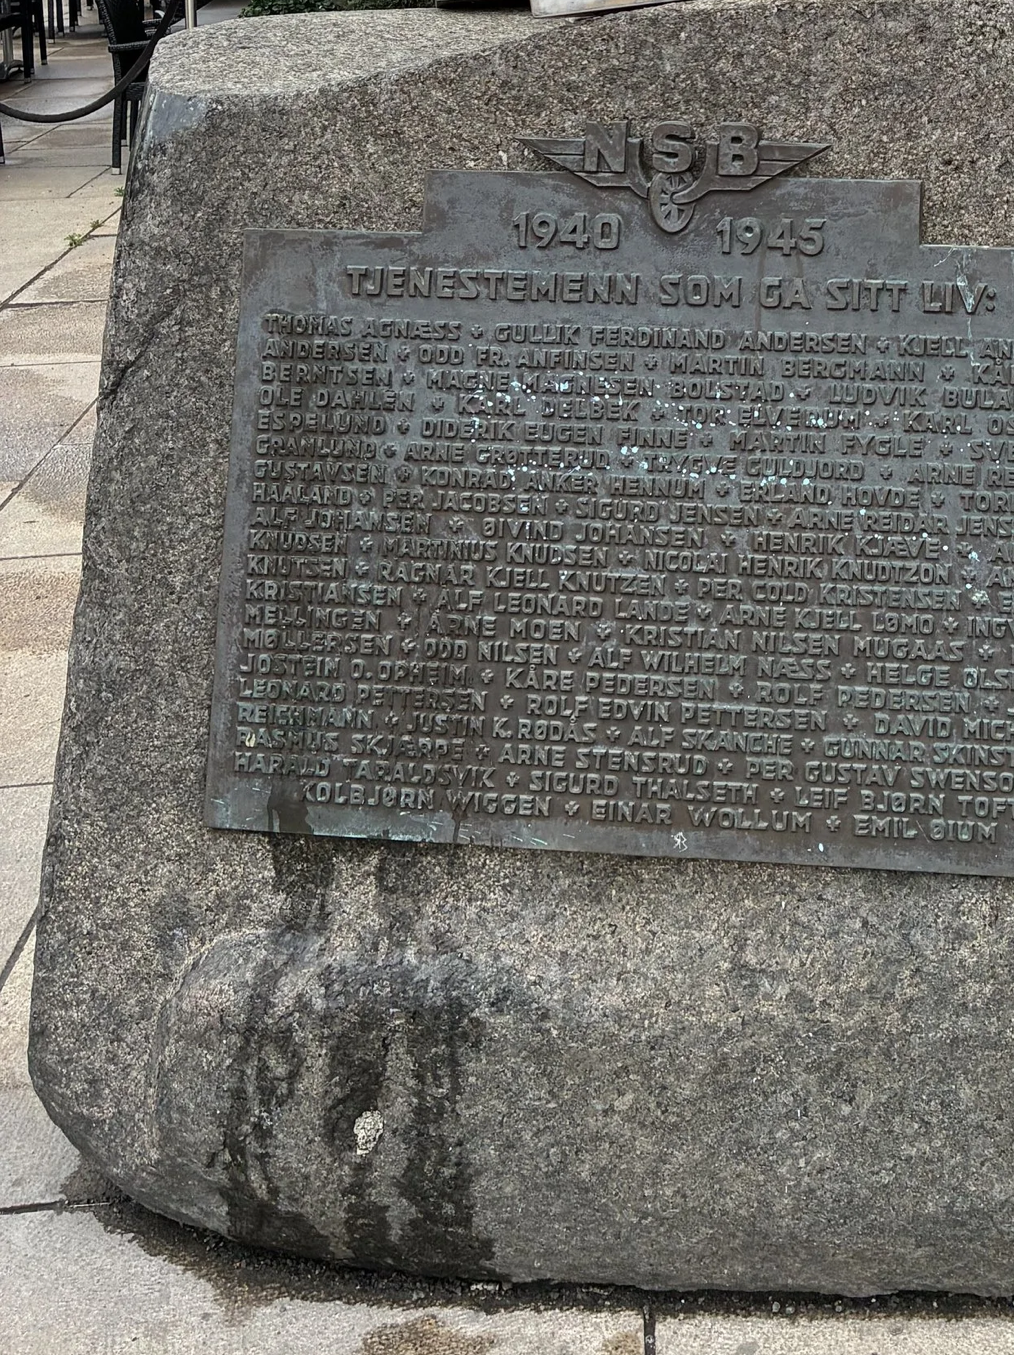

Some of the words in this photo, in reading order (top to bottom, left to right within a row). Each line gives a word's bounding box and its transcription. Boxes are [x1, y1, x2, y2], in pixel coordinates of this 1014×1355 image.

[584, 119, 761, 177] NSB
[511, 210, 624, 252] 1940
[716, 215, 828, 257] 1945
[345, 263, 641, 306] TJENESTEMENN
[659, 273, 743, 309] SOM
[758, 276, 813, 311] GA
[824, 278, 910, 314] SITT
[260, 338, 389, 364] ANDERSEN
[416, 343, 465, 367] ODD
[515, 346, 636, 373] ANFINSEN
[669, 352, 765, 377] MARTIN
[781, 355, 926, 383] BERGMANN
[261, 313, 354, 337] THOMAS
[493, 321, 581, 345] GULLIK
[589, 324, 726, 350] FERDINAND
[738, 329, 868, 354] ANDERSEN
[897, 334, 969, 358] KJELL
[243, 577, 403, 609] KRISTIANSEN
[436, 586, 485, 613] ALF
[492, 589, 604, 619] LEONARD
[613, 595, 692, 623] LANDE
[718, 600, 788, 628] ARNE
[793, 603, 863, 631] KJELL
[421, 636, 469, 663] ODD
[476, 638, 560, 667] NILSEN
[587, 644, 633, 671] ALF
[639, 646, 748, 677] WILHELM
[866, 658, 951, 687] HELGE
[508, 615, 582, 643] MOEN
[624, 621, 742, 651] KRISTIAN
[751, 627, 841, 656] NILSEN
[852, 632, 966, 662] MUGAAS
[231, 750, 331, 780] HARALD
[528, 767, 619, 797] SIGURD
[630, 773, 760, 805] THALSETH
[792, 782, 849, 810] LEIF
[859, 786, 946, 816] BJØRN
[443, 788, 552, 818] WIGGEN
[589, 796, 674, 825] EINAR
[686, 802, 812, 834] WOLLUM
[851, 811, 918, 840] EMIL
